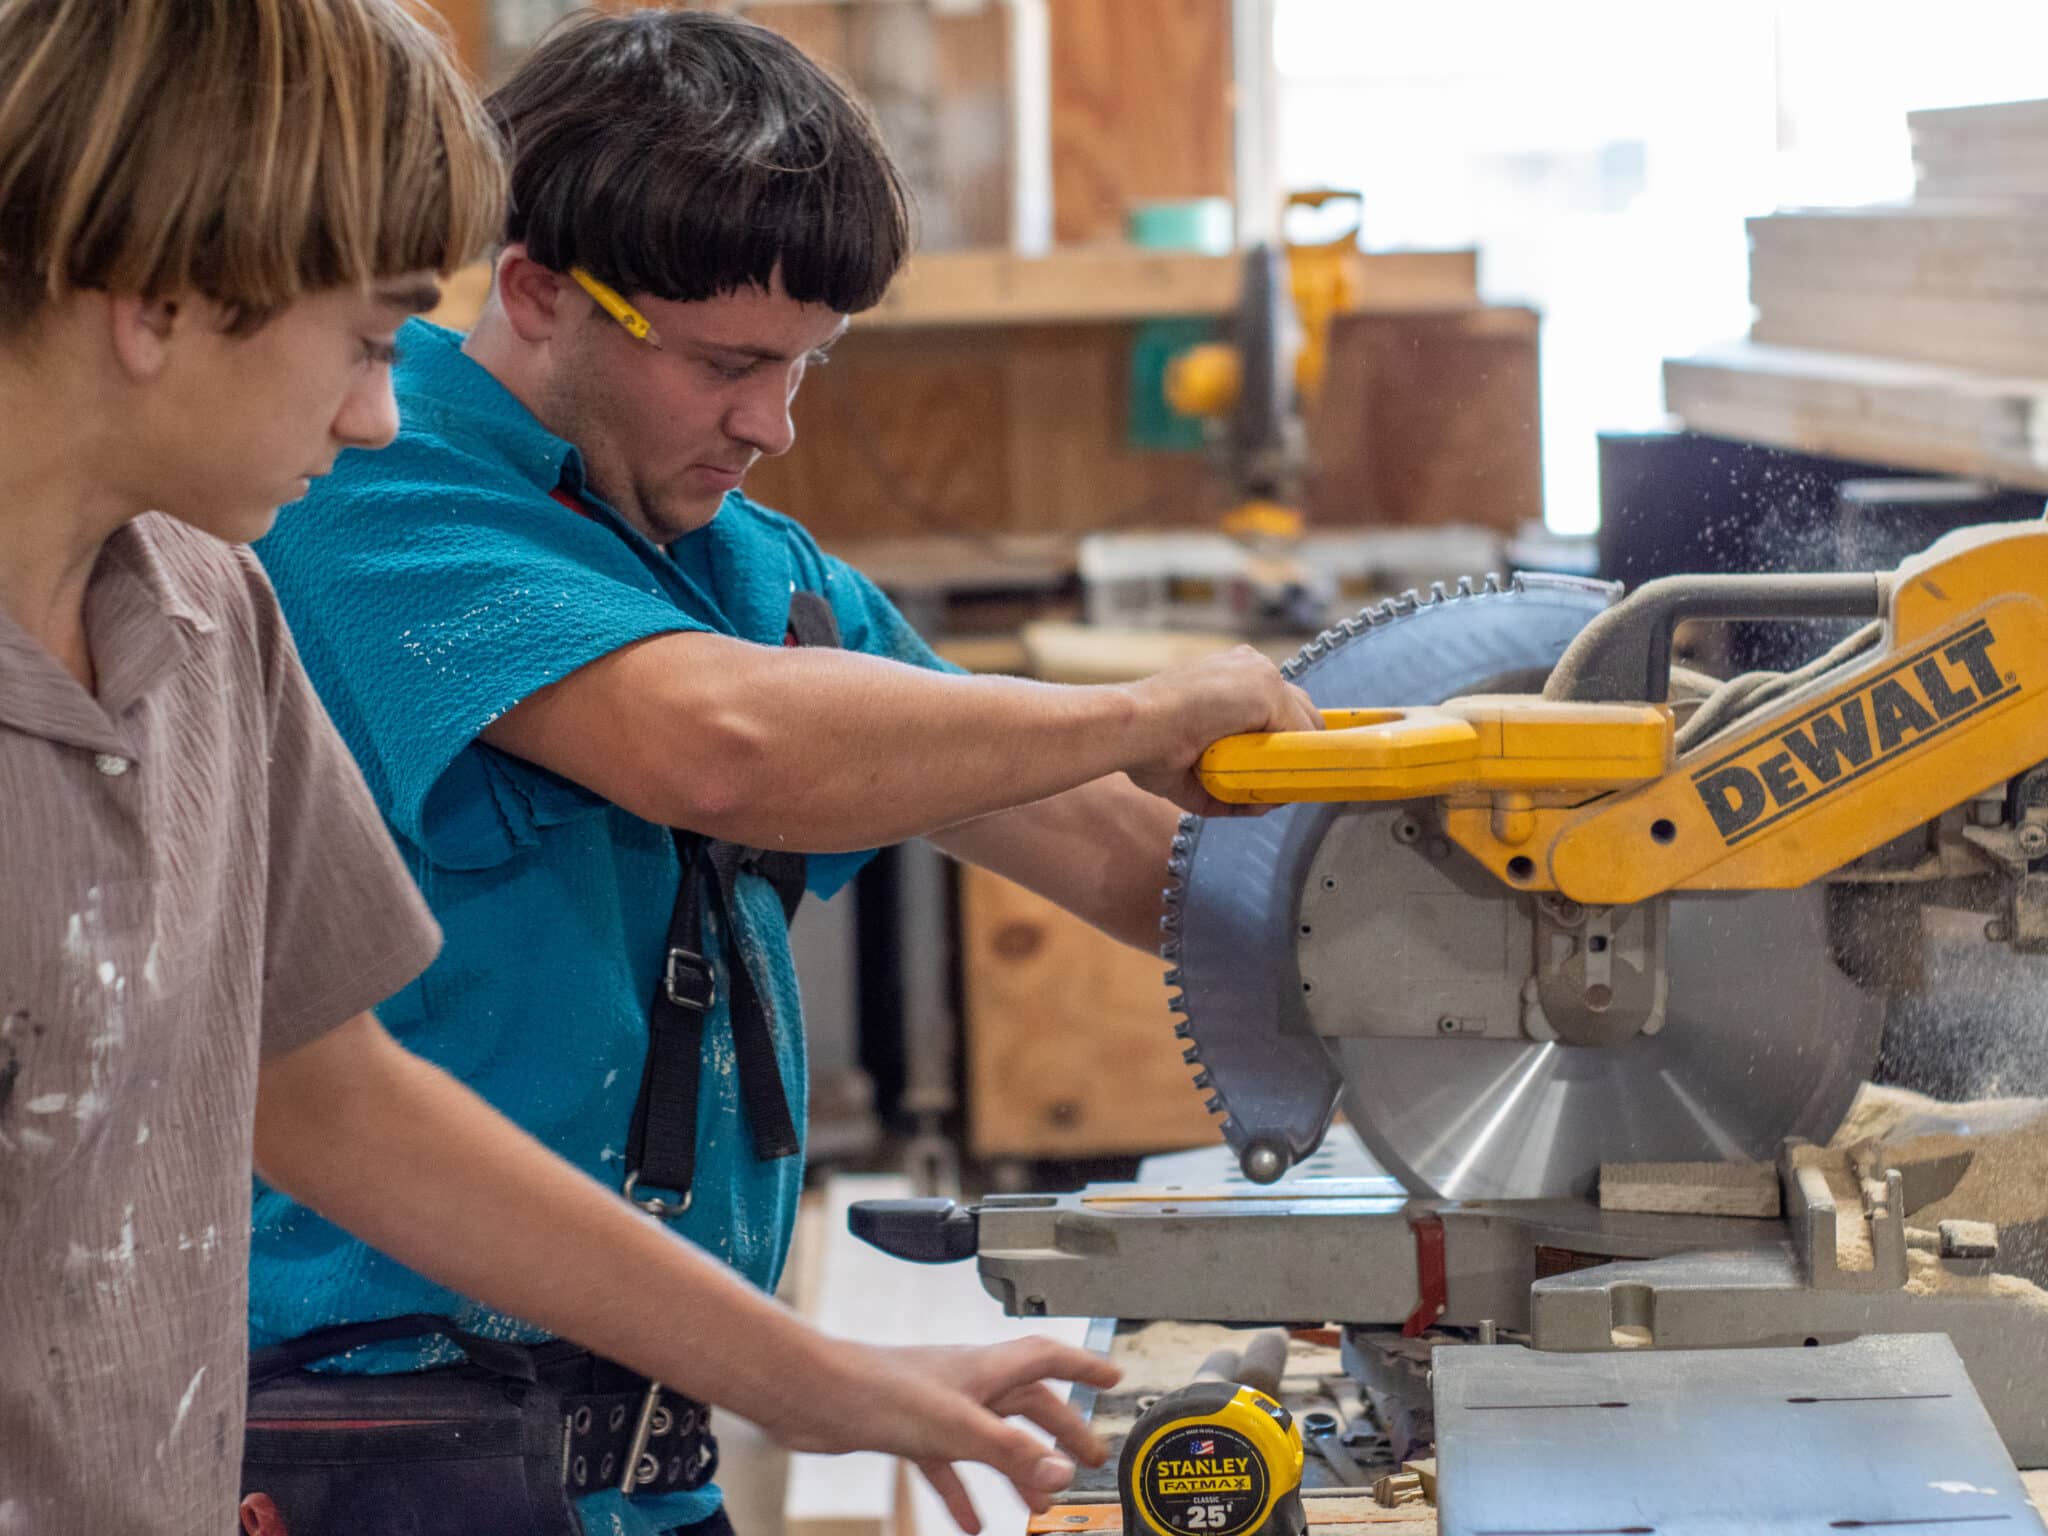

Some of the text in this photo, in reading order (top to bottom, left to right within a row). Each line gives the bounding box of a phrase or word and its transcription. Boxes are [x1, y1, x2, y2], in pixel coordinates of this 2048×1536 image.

[1157, 1457, 1248, 1477] STANLEY
[1164, 1478, 1246, 1491] FATMAX
[1193, 1496, 1219, 1505] CLASSIC
